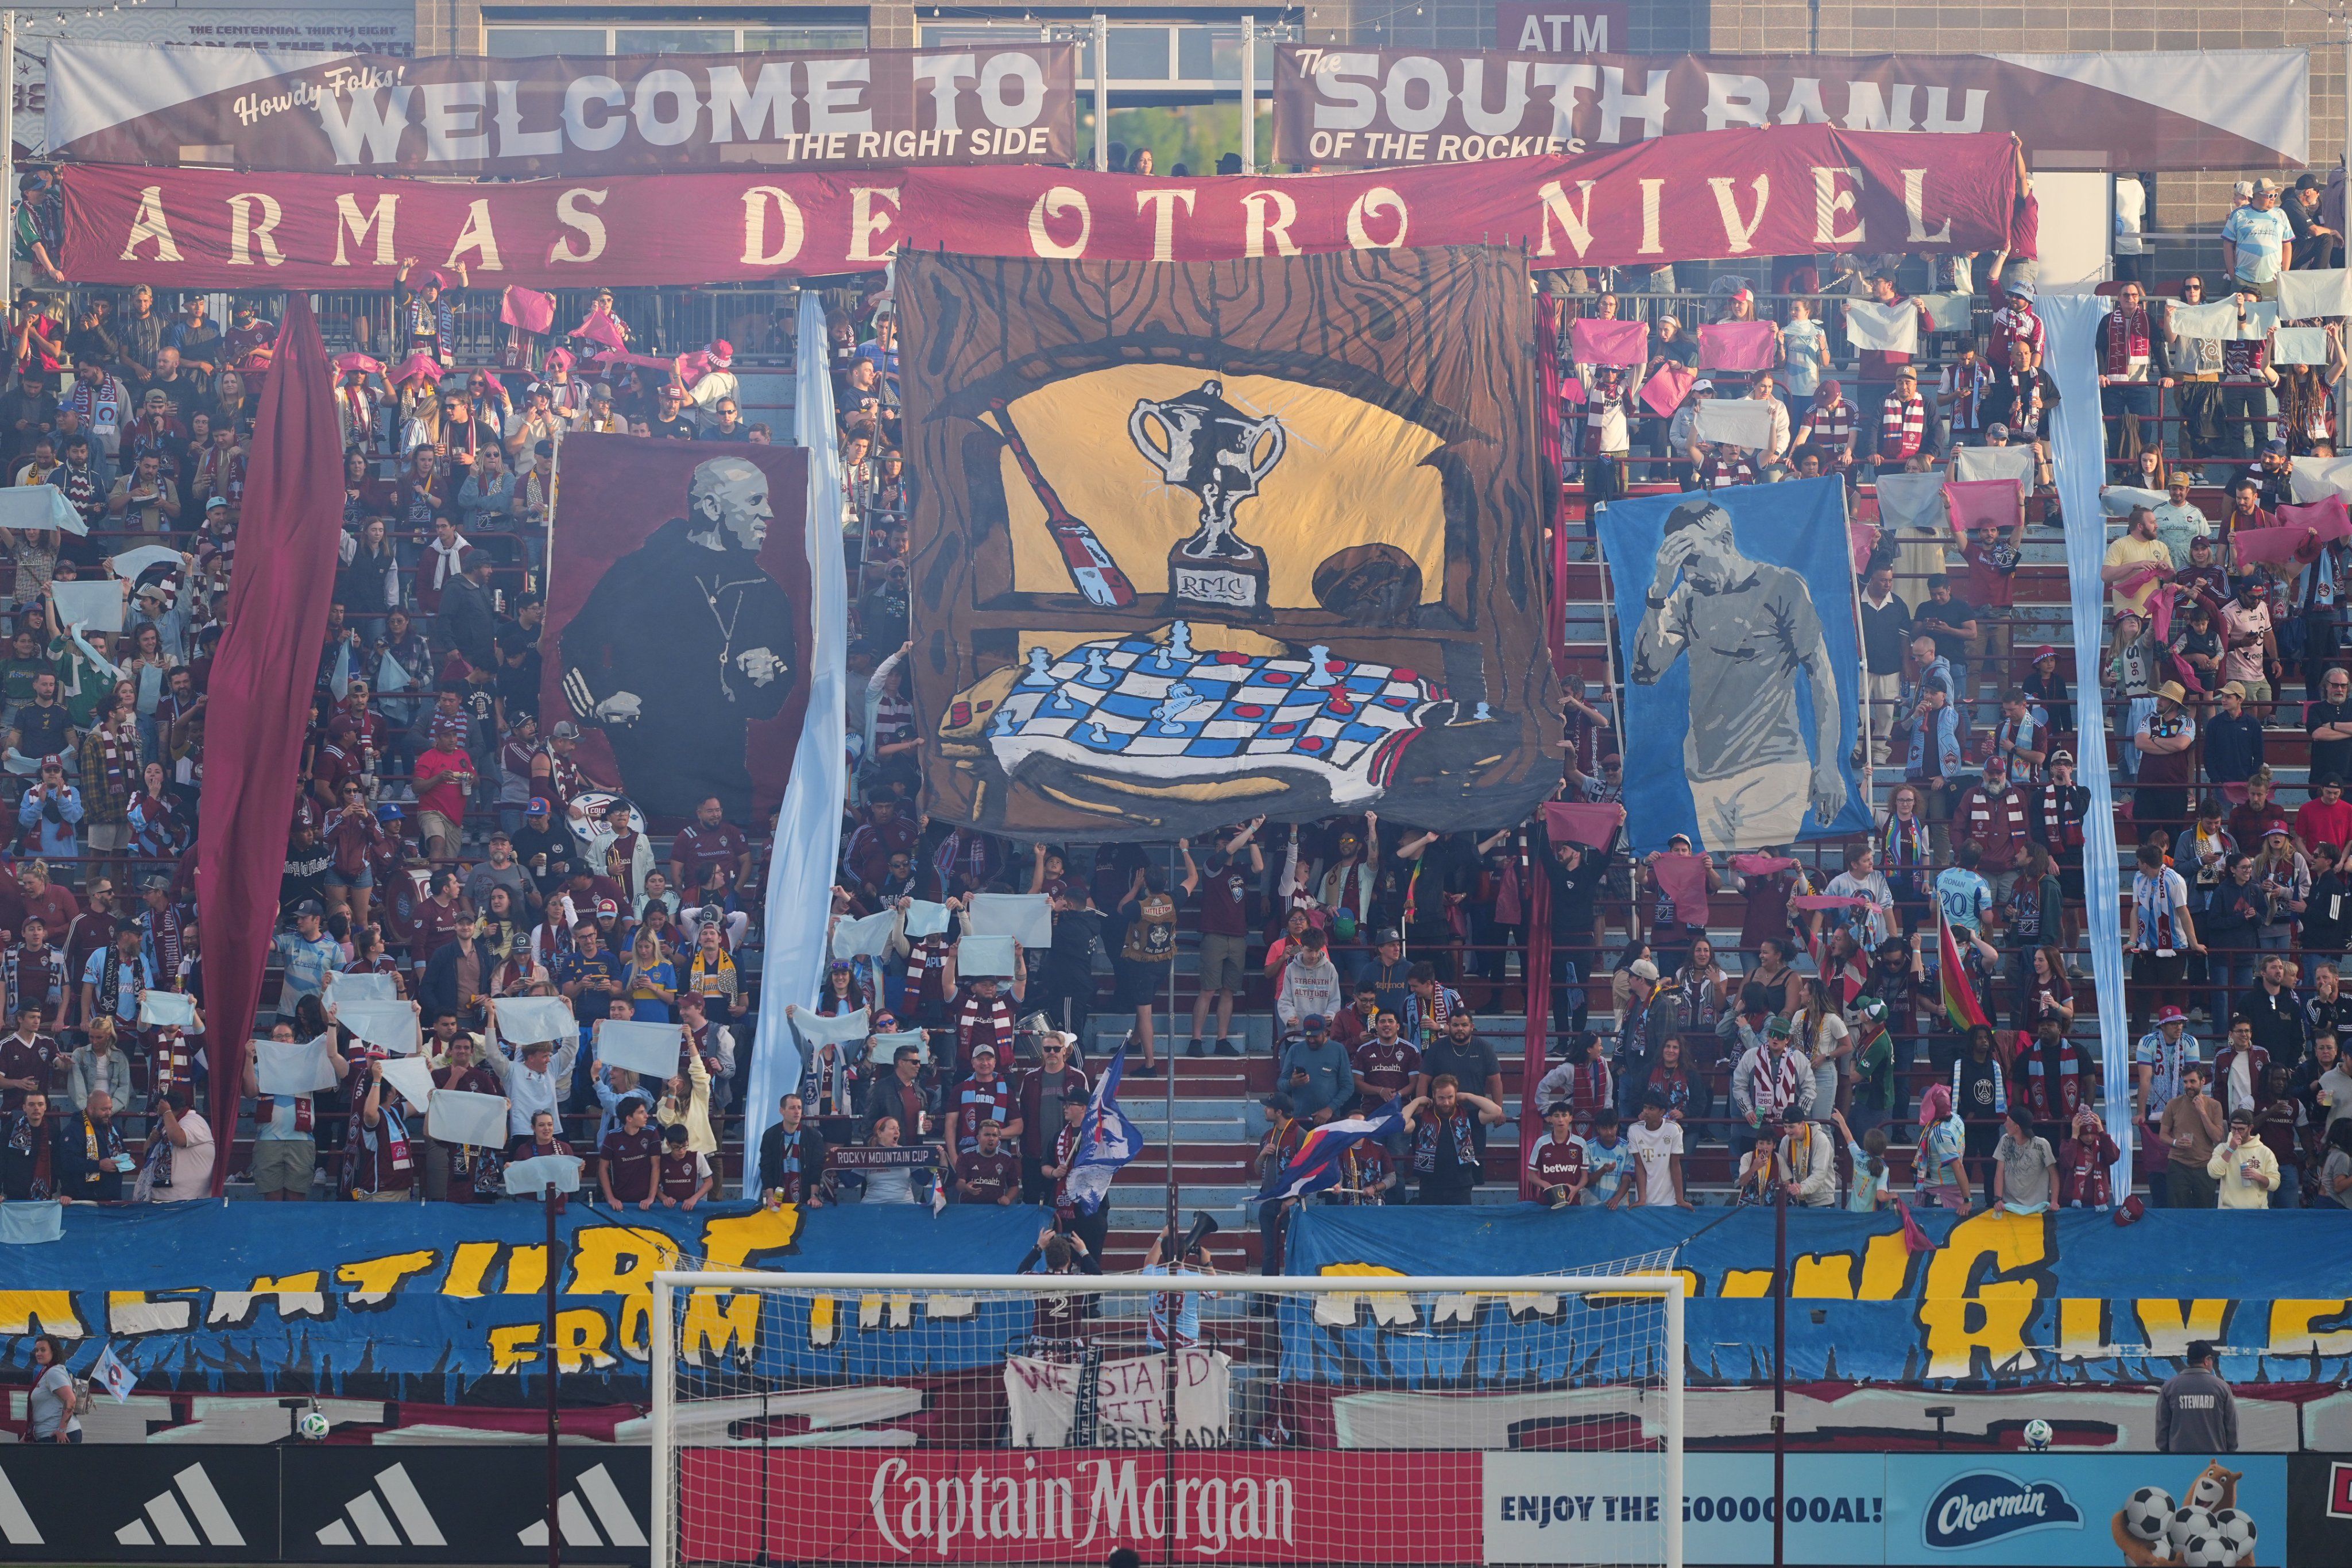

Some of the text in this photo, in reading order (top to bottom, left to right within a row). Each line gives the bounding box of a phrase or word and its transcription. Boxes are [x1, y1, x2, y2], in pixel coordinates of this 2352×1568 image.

[188, 26, 397, 38] THE CENTENNIAL THIRTY EIGHT
[1517, 15, 1608, 52] ATM
[1295, 48, 1341, 79] The
[233, 66, 405, 126] Howdy Folks!
[319, 52, 1048, 165] WELCOME TO
[1313, 52, 1670, 144] SOUTH
[783, 127, 1050, 160] THE RIGHT SIDE
[1309, 131, 1354, 157] OF
[1365, 133, 1426, 160] THE
[119, 167, 1951, 272] ARMAS DE OTRO NIVEL
[1181, 576, 1245, 595] RMC
[46, 754, 58, 763] COL
[1943, 877, 1966, 888] RONAN
[1145, 905, 1171, 916] LITTLETON
[1939, 889, 1967, 917] 20
[1294, 989, 1329, 997] ALTITUDE
[1372, 1063, 1401, 1072] uchealth
[837, 1151, 933, 1164] ROCKY MOUNTAIN CUP
[1543, 1164, 1578, 1174] betway
[972, 1176, 1001, 1186] uchealth
[1049, 1295, 1069, 1318] 2
[1009, 1358, 1077, 1395] WE
[1096, 1352, 1210, 1396] STAND
[1081, 1370, 1094, 1411] PLACE
[2179, 1394, 2215, 1410] STEWARD
[1080, 1417, 1092, 1443] THE
[869, 1457, 1294, 1555] Captain Morgan
[1501, 1496, 1595, 1528] ENJOY
[1603, 1496, 1659, 1523] THE
[1937, 1485, 2047, 1535] Charmin
